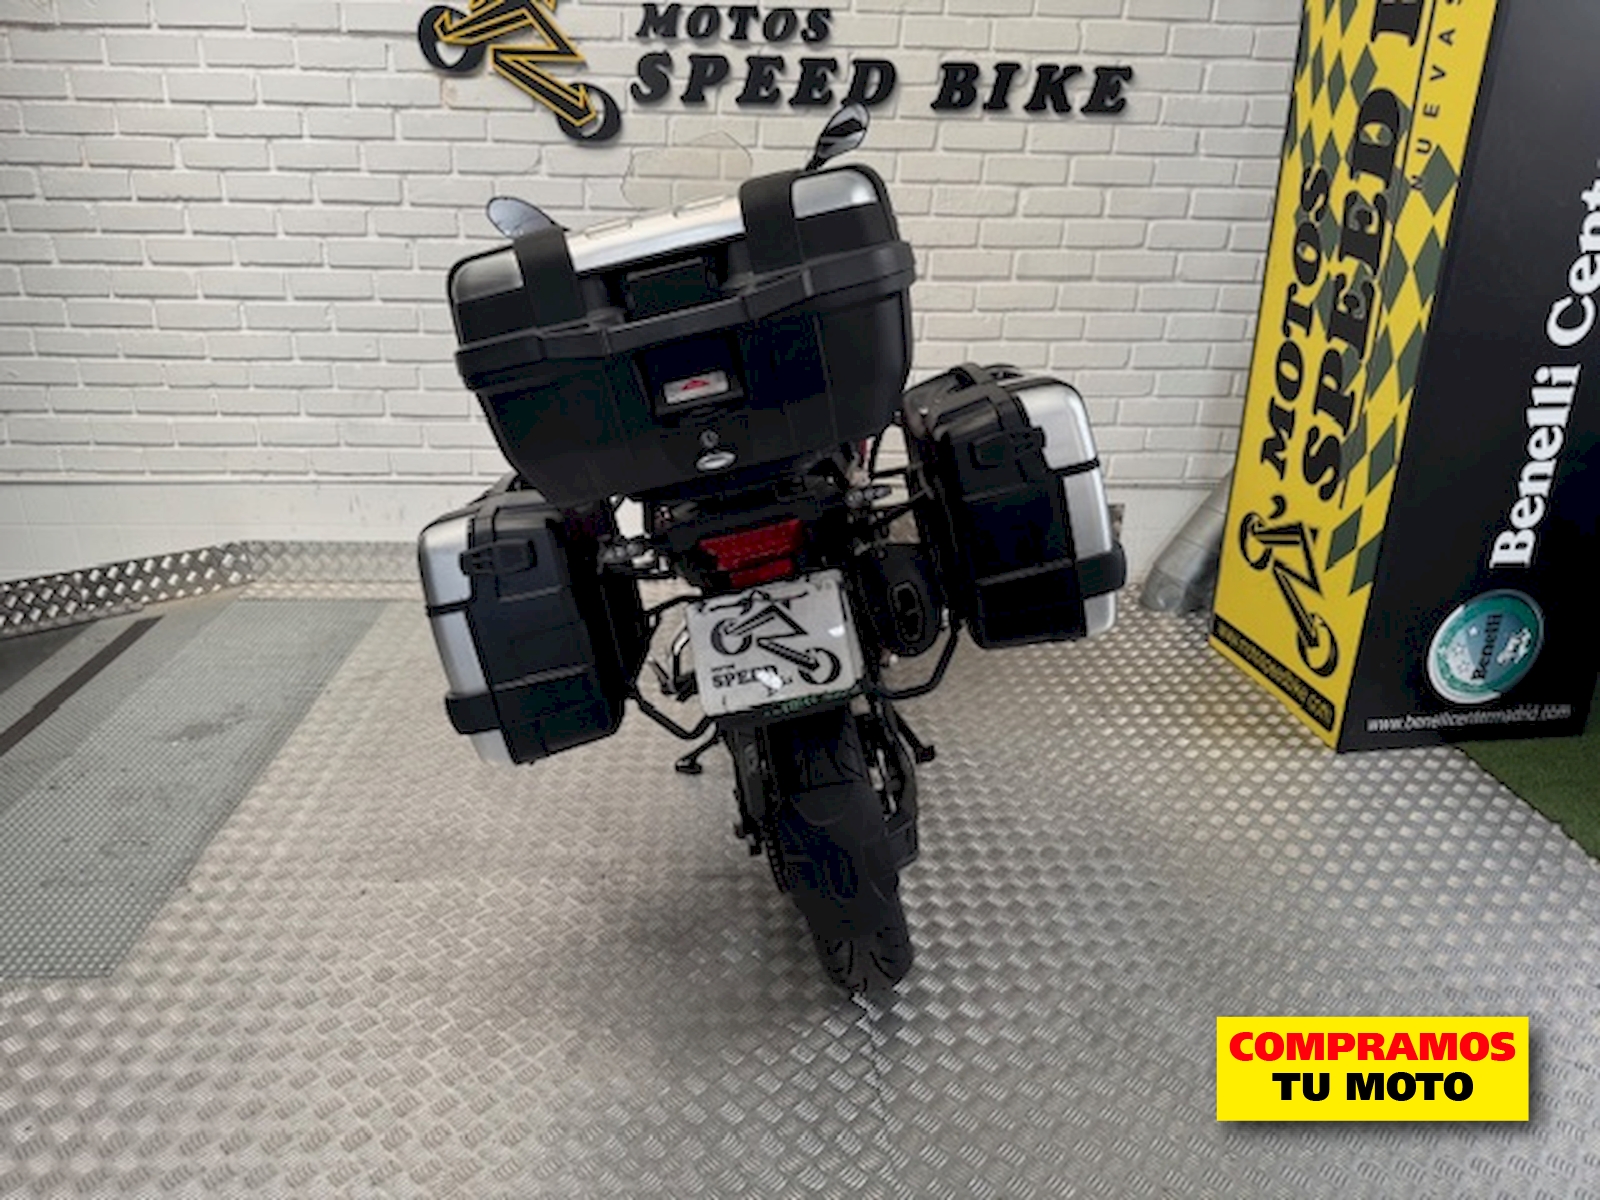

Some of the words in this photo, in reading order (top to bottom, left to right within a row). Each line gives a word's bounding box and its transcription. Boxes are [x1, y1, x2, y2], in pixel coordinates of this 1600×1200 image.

[630, 52, 897, 109] SPEED
[931, 61, 1134, 114] BIKE
[636, 4, 832, 42] MOTOS
[1409, 0, 1462, 191] NUEVA
[1261, 166, 1330, 480] MOTOS
[1303, 87, 1400, 501] SPEED
[1489, 363, 1583, 569] Benelli
[1547, 159, 1600, 347] Cent
[1471, 613, 1503, 681] Benelli
